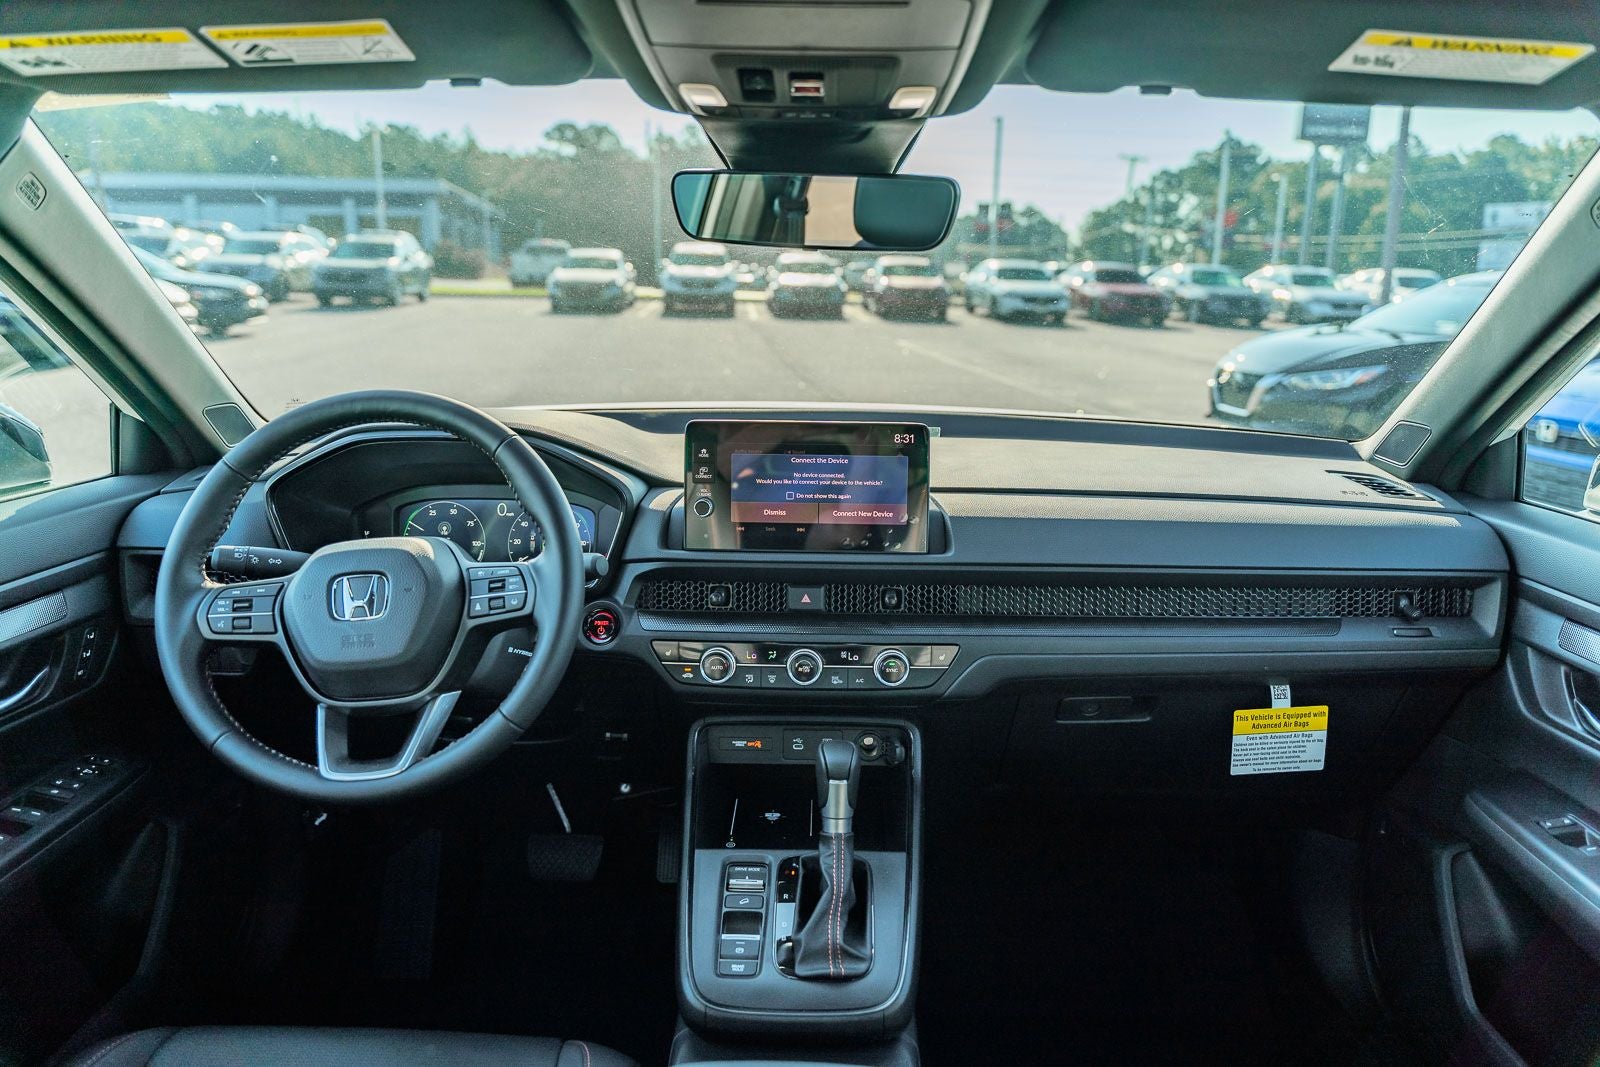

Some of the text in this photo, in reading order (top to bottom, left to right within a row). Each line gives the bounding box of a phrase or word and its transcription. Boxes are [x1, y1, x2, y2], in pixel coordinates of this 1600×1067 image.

[894, 434, 914, 444] 8:31
[497, 503, 507, 516] 0
[746, 650, 757, 659] Lo
[848, 652, 859, 661] Lo
